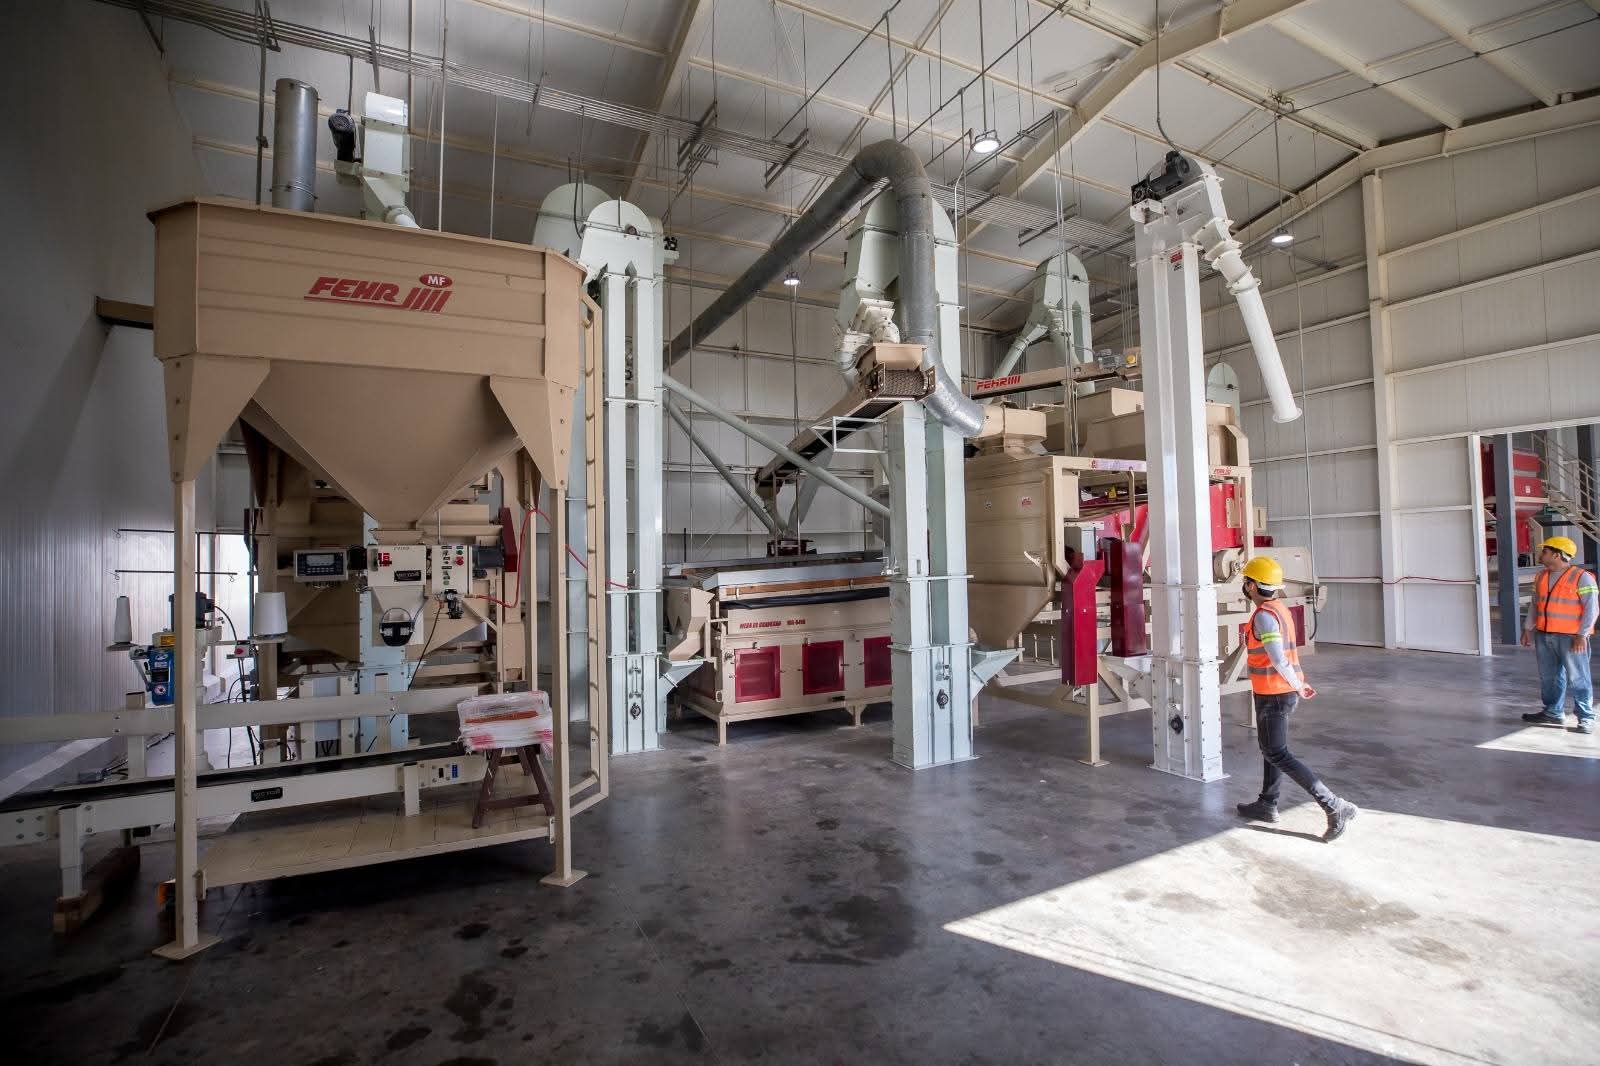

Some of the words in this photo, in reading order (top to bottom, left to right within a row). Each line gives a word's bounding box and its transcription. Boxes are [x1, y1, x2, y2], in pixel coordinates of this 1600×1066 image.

[427, 275, 446, 287] MF
[308, 276, 400, 302] FEHR
[976, 377, 1008, 391] FEHR
